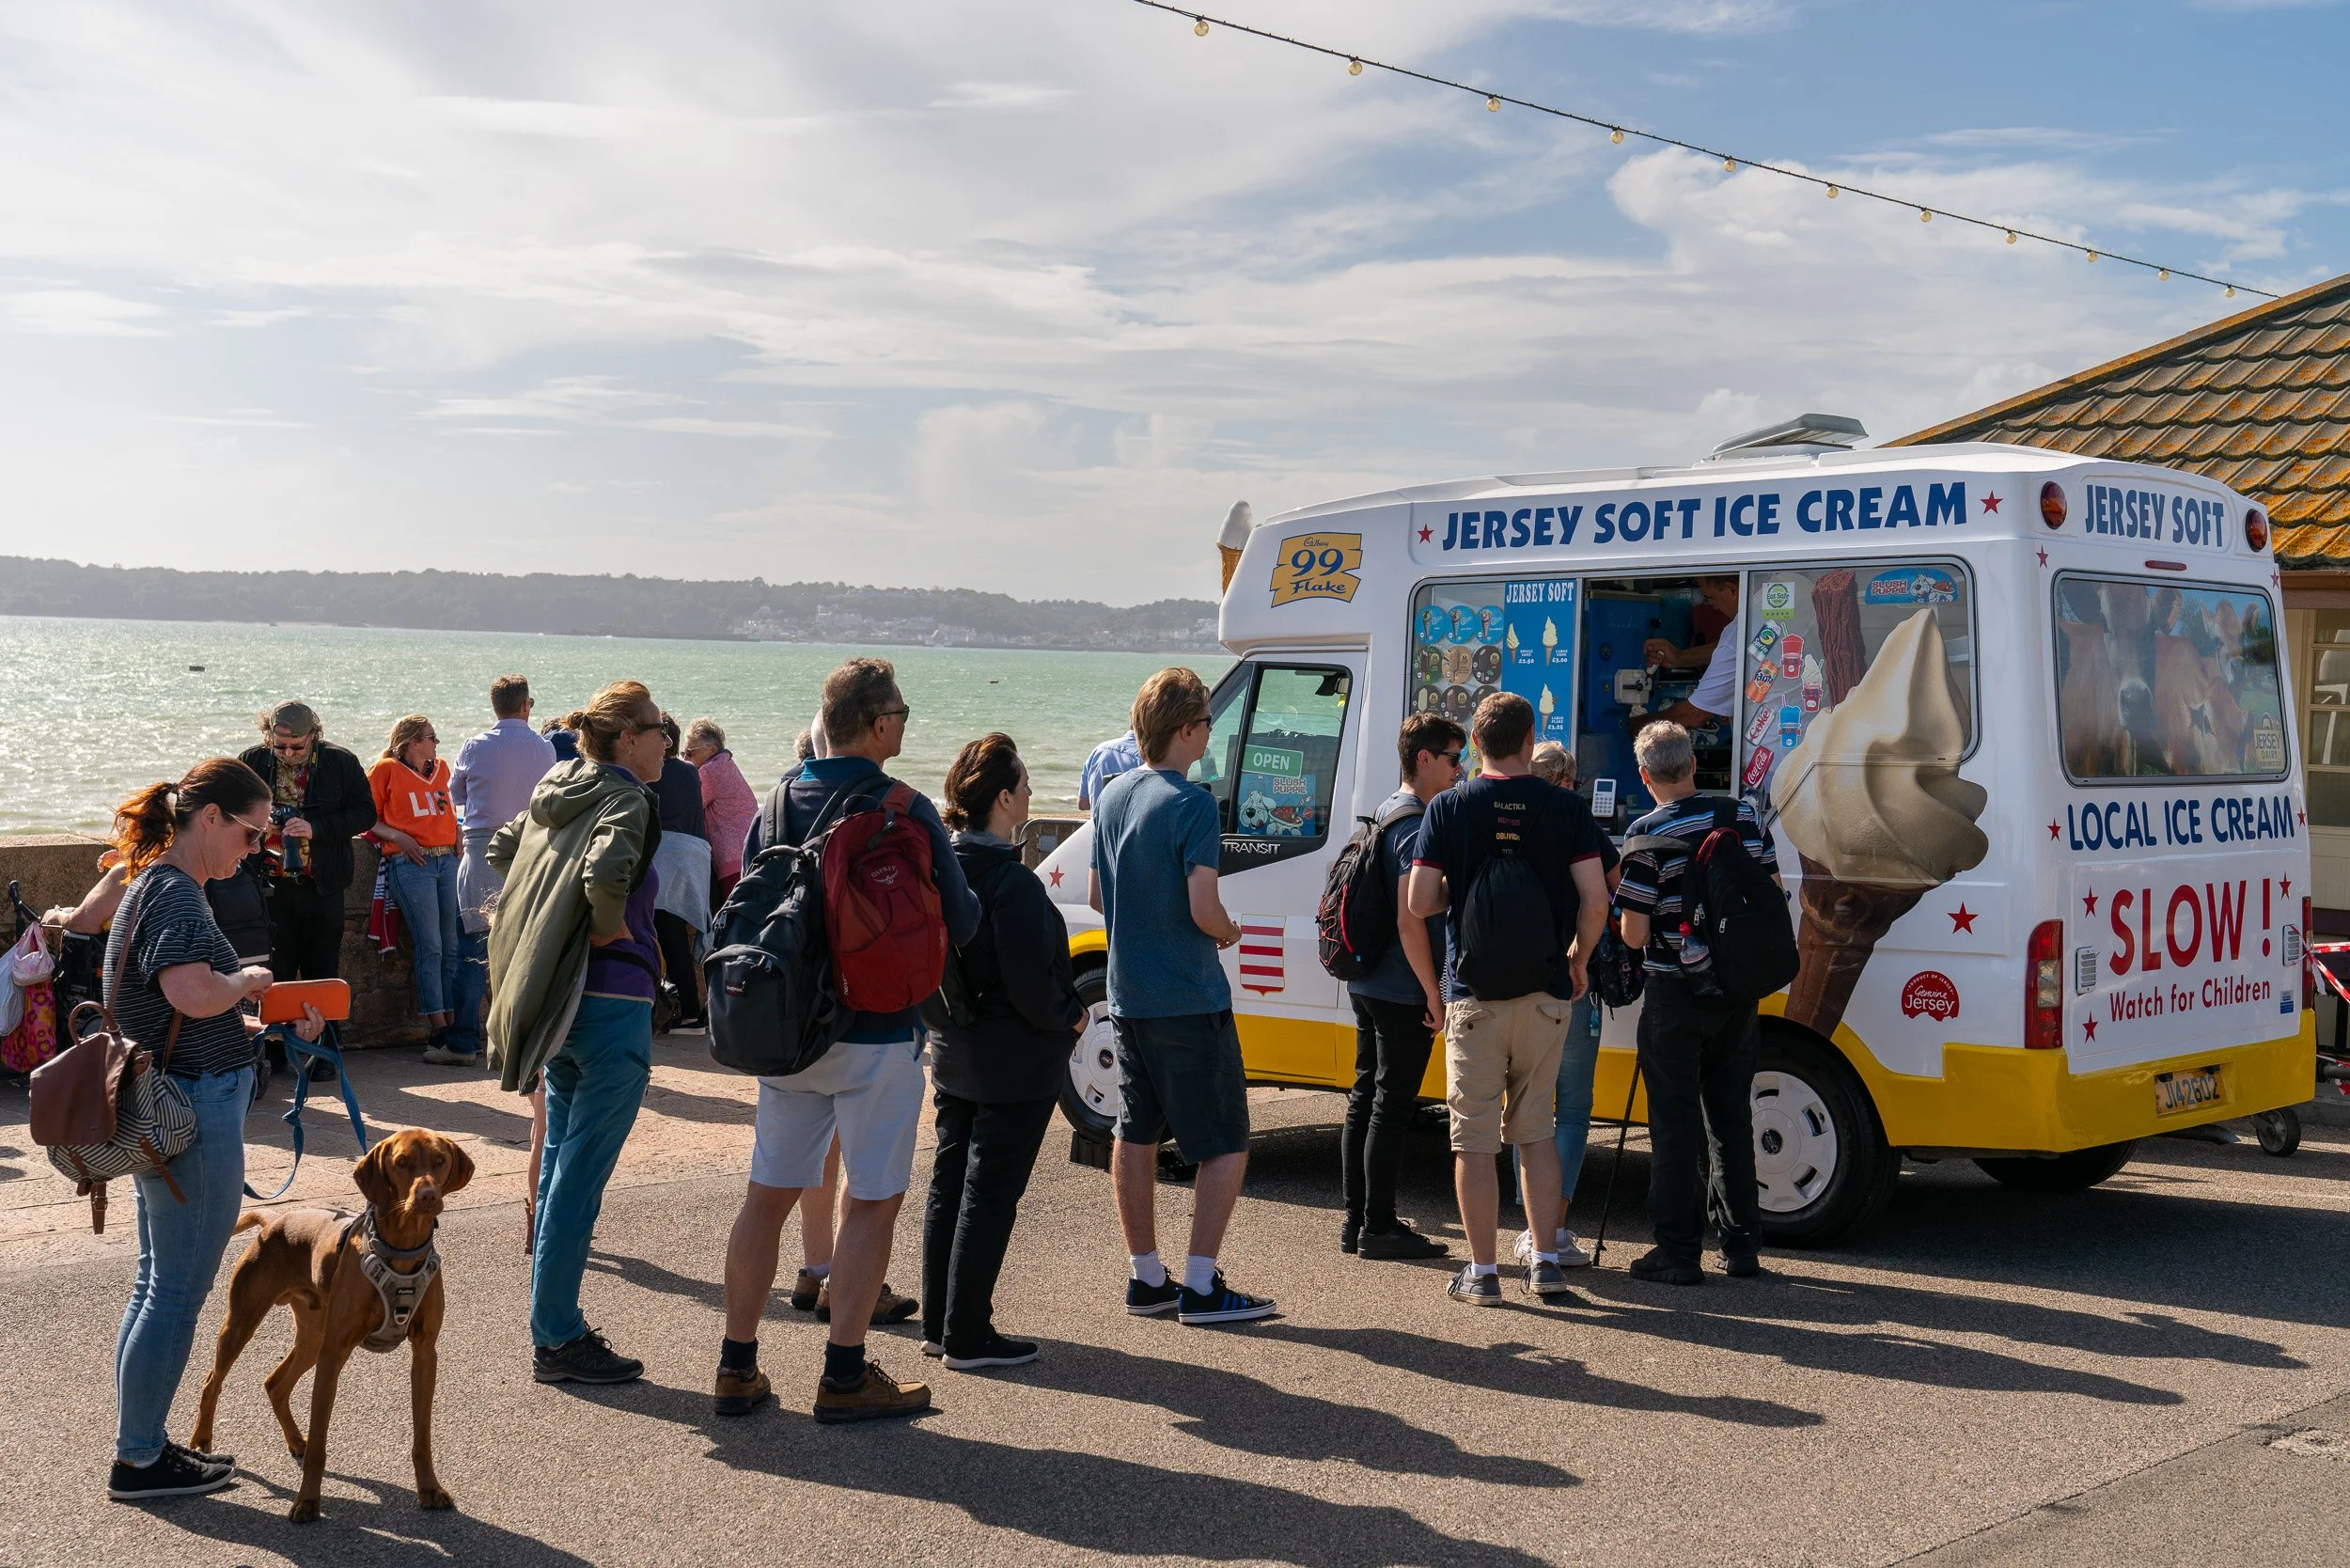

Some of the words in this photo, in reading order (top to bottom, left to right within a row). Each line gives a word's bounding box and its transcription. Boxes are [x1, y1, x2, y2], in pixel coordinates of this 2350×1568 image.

[1442, 505, 1584, 552] JERSEY
[1593, 497, 1701, 544] SOFT
[1714, 493, 1780, 538] ICE
[1796, 481, 1966, 533] CREAM
[2085, 484, 2166, 541] JERSEY
[2171, 495, 2224, 548] SOFT
[1303, 536, 1330, 548] Cadbury
[1291, 548, 1343, 577] 99
[1290, 577, 1346, 595] Flake
[1506, 583, 1545, 604] JERSEY
[1547, 582, 1574, 603] SOFT
[1872, 579, 1907, 589] SLUSH
[1872, 587, 1908, 596] PUPPIE
[1753, 638, 1769, 653] Sprite
[1749, 710, 1770, 740] Coke
[2255, 732, 2280, 749] JERSEY
[1253, 752, 1291, 771] OPEN
[1273, 777, 1308, 787] SLUSH
[1273, 784, 1308, 794] PUPPIE
[1494, 801, 1527, 810] GALACTICA
[2067, 801, 2157, 851] LOCAL
[2164, 798, 2203, 846] ICE
[2210, 795, 2295, 843] CREAM
[1222, 839, 1281, 855] TRANSIT
[2108, 880, 2247, 977] SLOW
[1907, 974, 1929, 989] PRODUCT
[1938, 977, 1954, 993] JERSEY
[1914, 984, 1948, 999] Genuine
[1904, 994, 1955, 1015] Jersey
[2109, 985, 2163, 1023] Watch
[2170, 983, 2195, 1013] for
[2201, 974, 2270, 1009] Children
[2165, 1074, 2220, 1109] J142602
